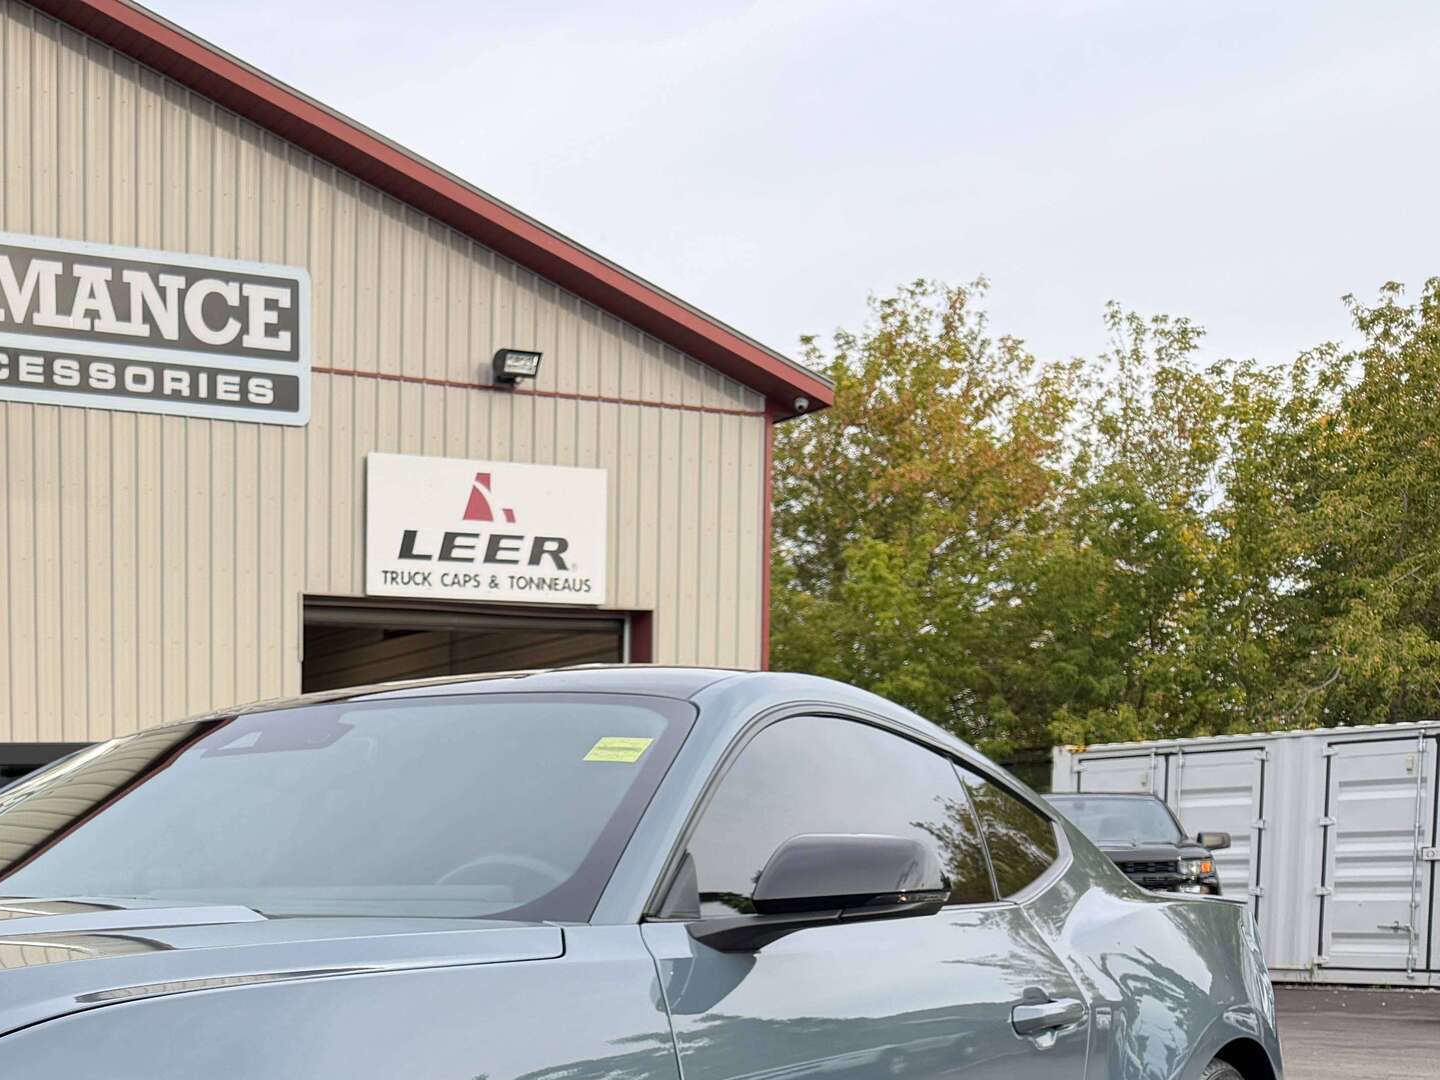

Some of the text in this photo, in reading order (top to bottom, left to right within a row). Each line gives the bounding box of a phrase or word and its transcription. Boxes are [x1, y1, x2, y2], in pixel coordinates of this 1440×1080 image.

[398, 529, 569, 571] LEER
[381, 570, 592, 593] TRUCK CAPS & TONNEAUS
